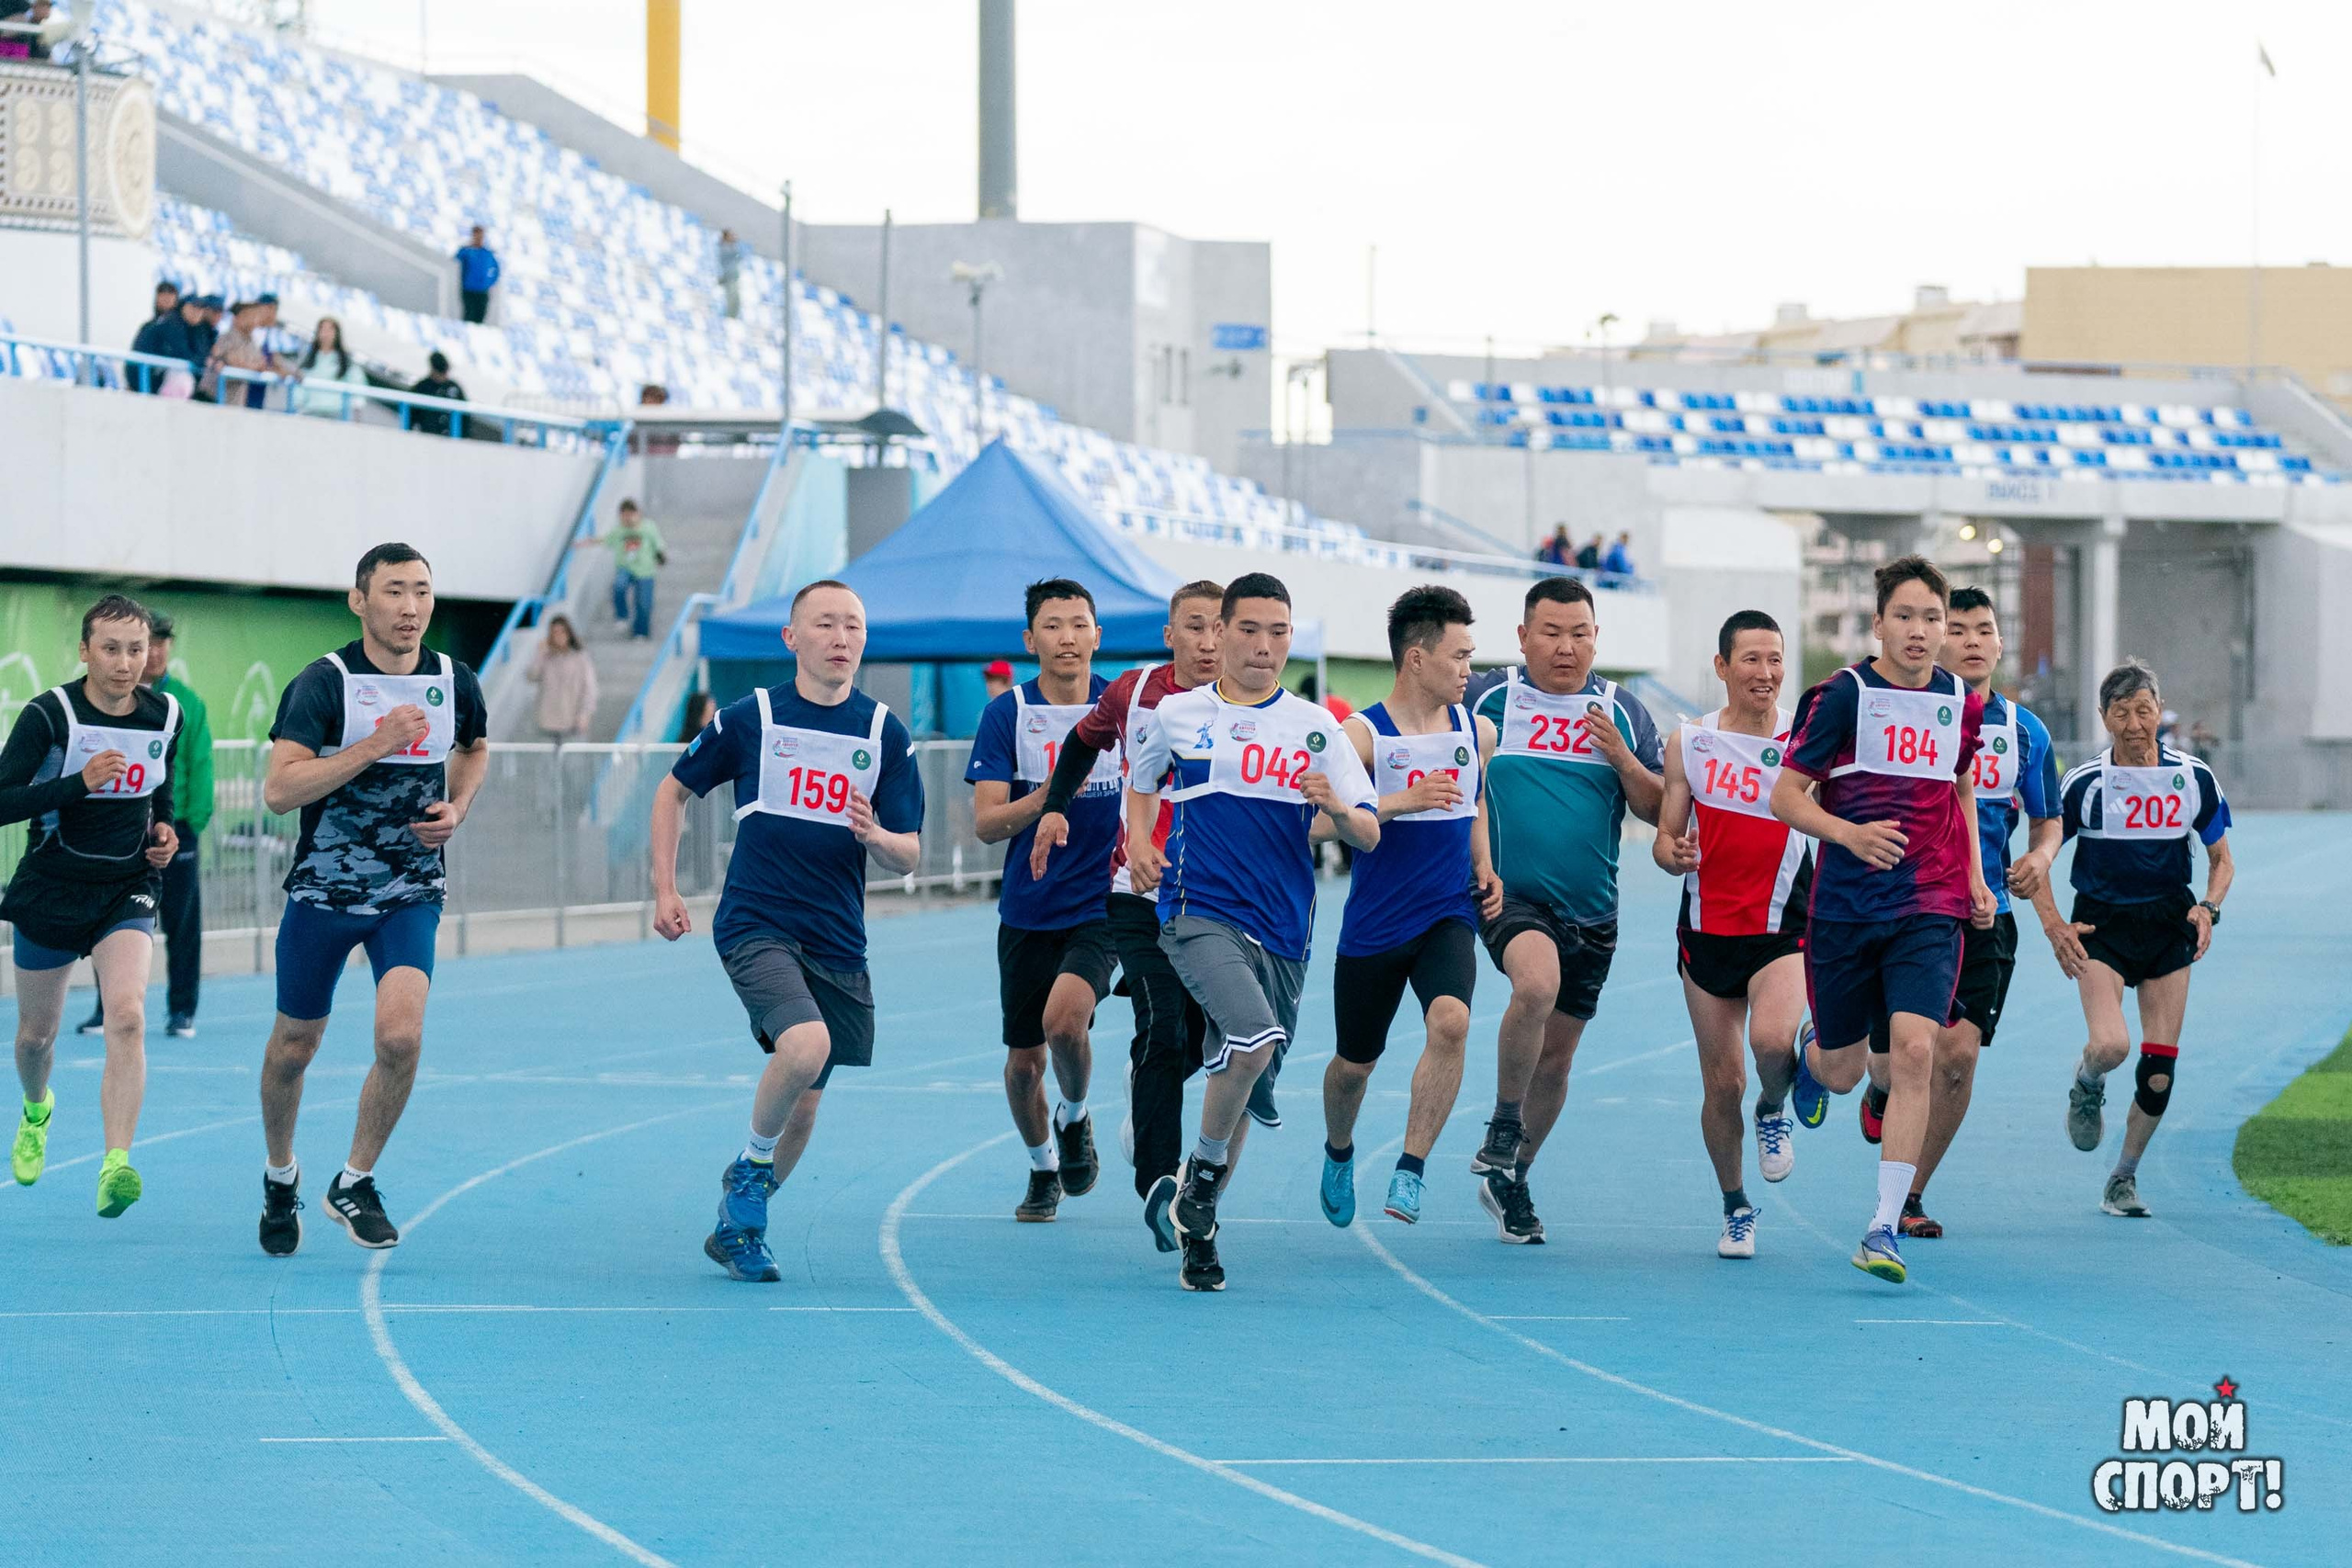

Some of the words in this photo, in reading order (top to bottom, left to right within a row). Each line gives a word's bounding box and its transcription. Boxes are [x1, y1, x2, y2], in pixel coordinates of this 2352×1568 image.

[1528, 715, 1592, 753] 232
[1884, 725, 1939, 766] 184
[1241, 743, 1310, 790] 042
[1704, 758, 1761, 804] 145
[788, 766, 850, 814] 159
[2125, 794, 2182, 829] 202
